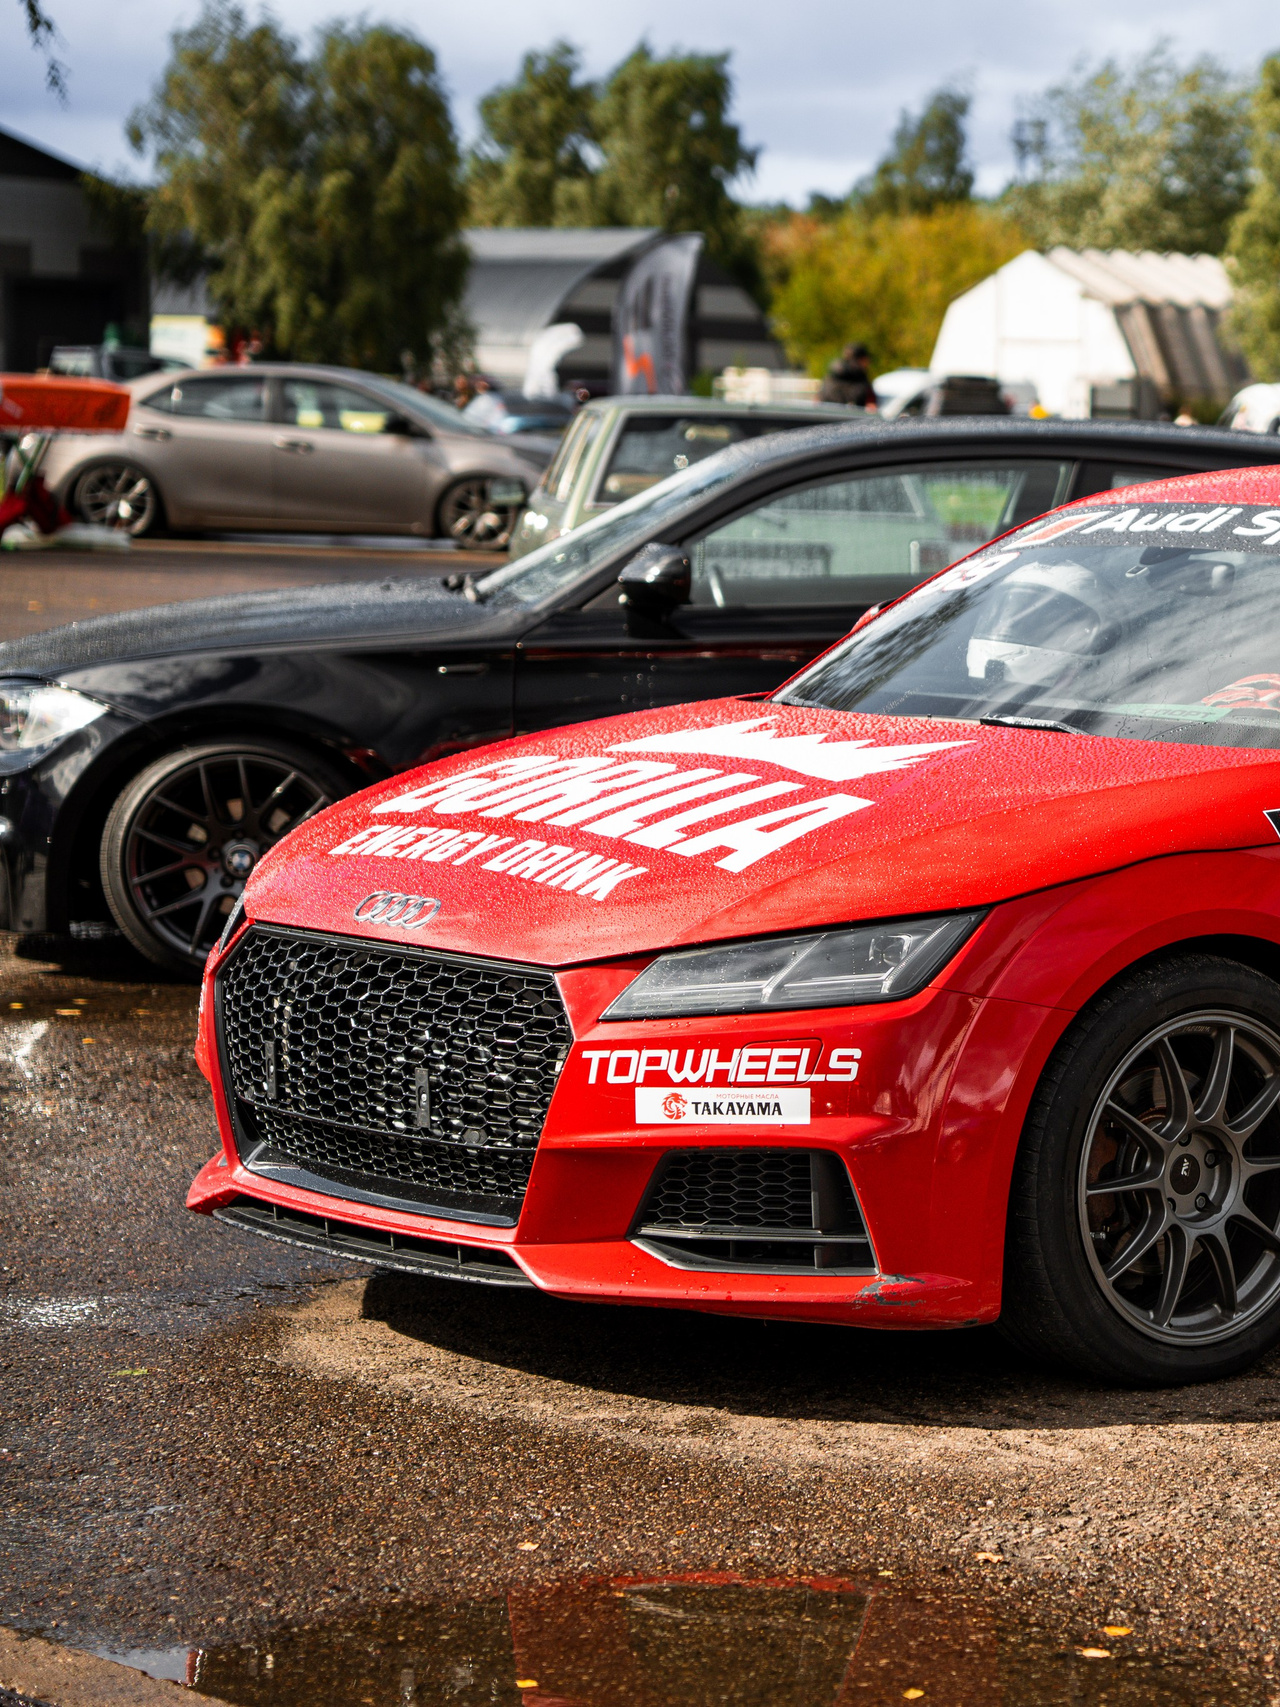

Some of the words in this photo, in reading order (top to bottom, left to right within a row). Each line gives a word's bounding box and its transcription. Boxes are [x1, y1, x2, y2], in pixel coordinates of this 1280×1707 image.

[1079, 508, 1243, 533] Audi
[370, 756, 875, 873] GORILLA
[328, 824, 515, 865] ENERGY
[481, 839, 648, 901] DRINK
[581, 1047, 862, 1084] TOPWHEELS
[691, 1101, 783, 1116] TAKAYAMA
